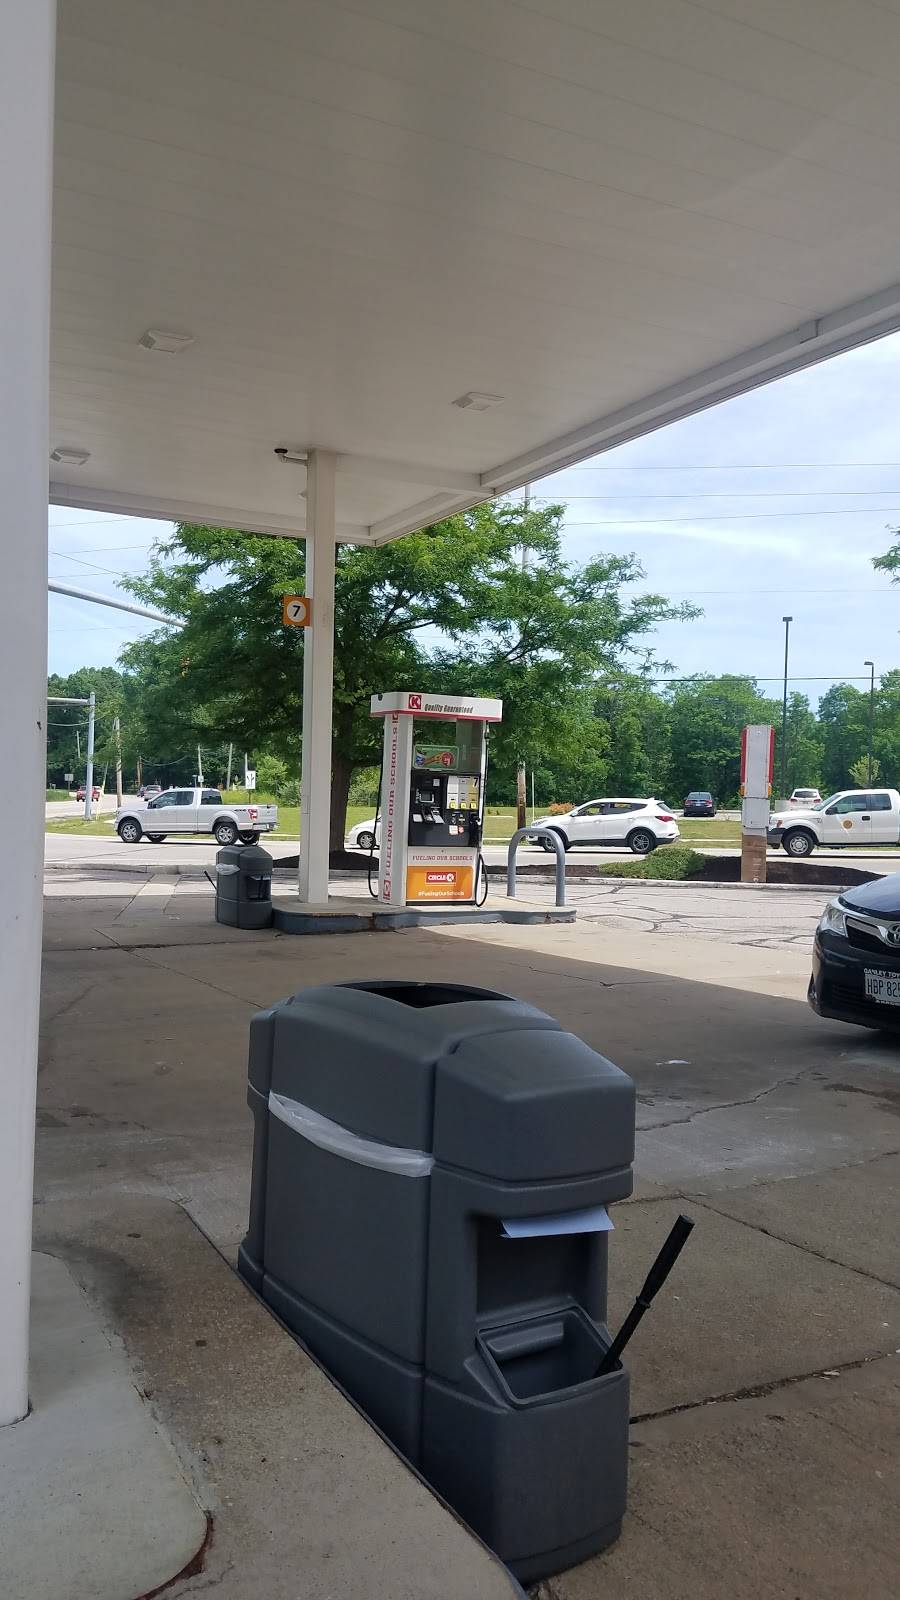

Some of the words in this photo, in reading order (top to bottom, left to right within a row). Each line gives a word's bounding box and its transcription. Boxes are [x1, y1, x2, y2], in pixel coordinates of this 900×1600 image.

[292, 604, 301, 617] 7
[424, 703, 444, 712] Quality
[444, 704, 474, 714] Guaranteed
[473, 777, 478, 787] 7
